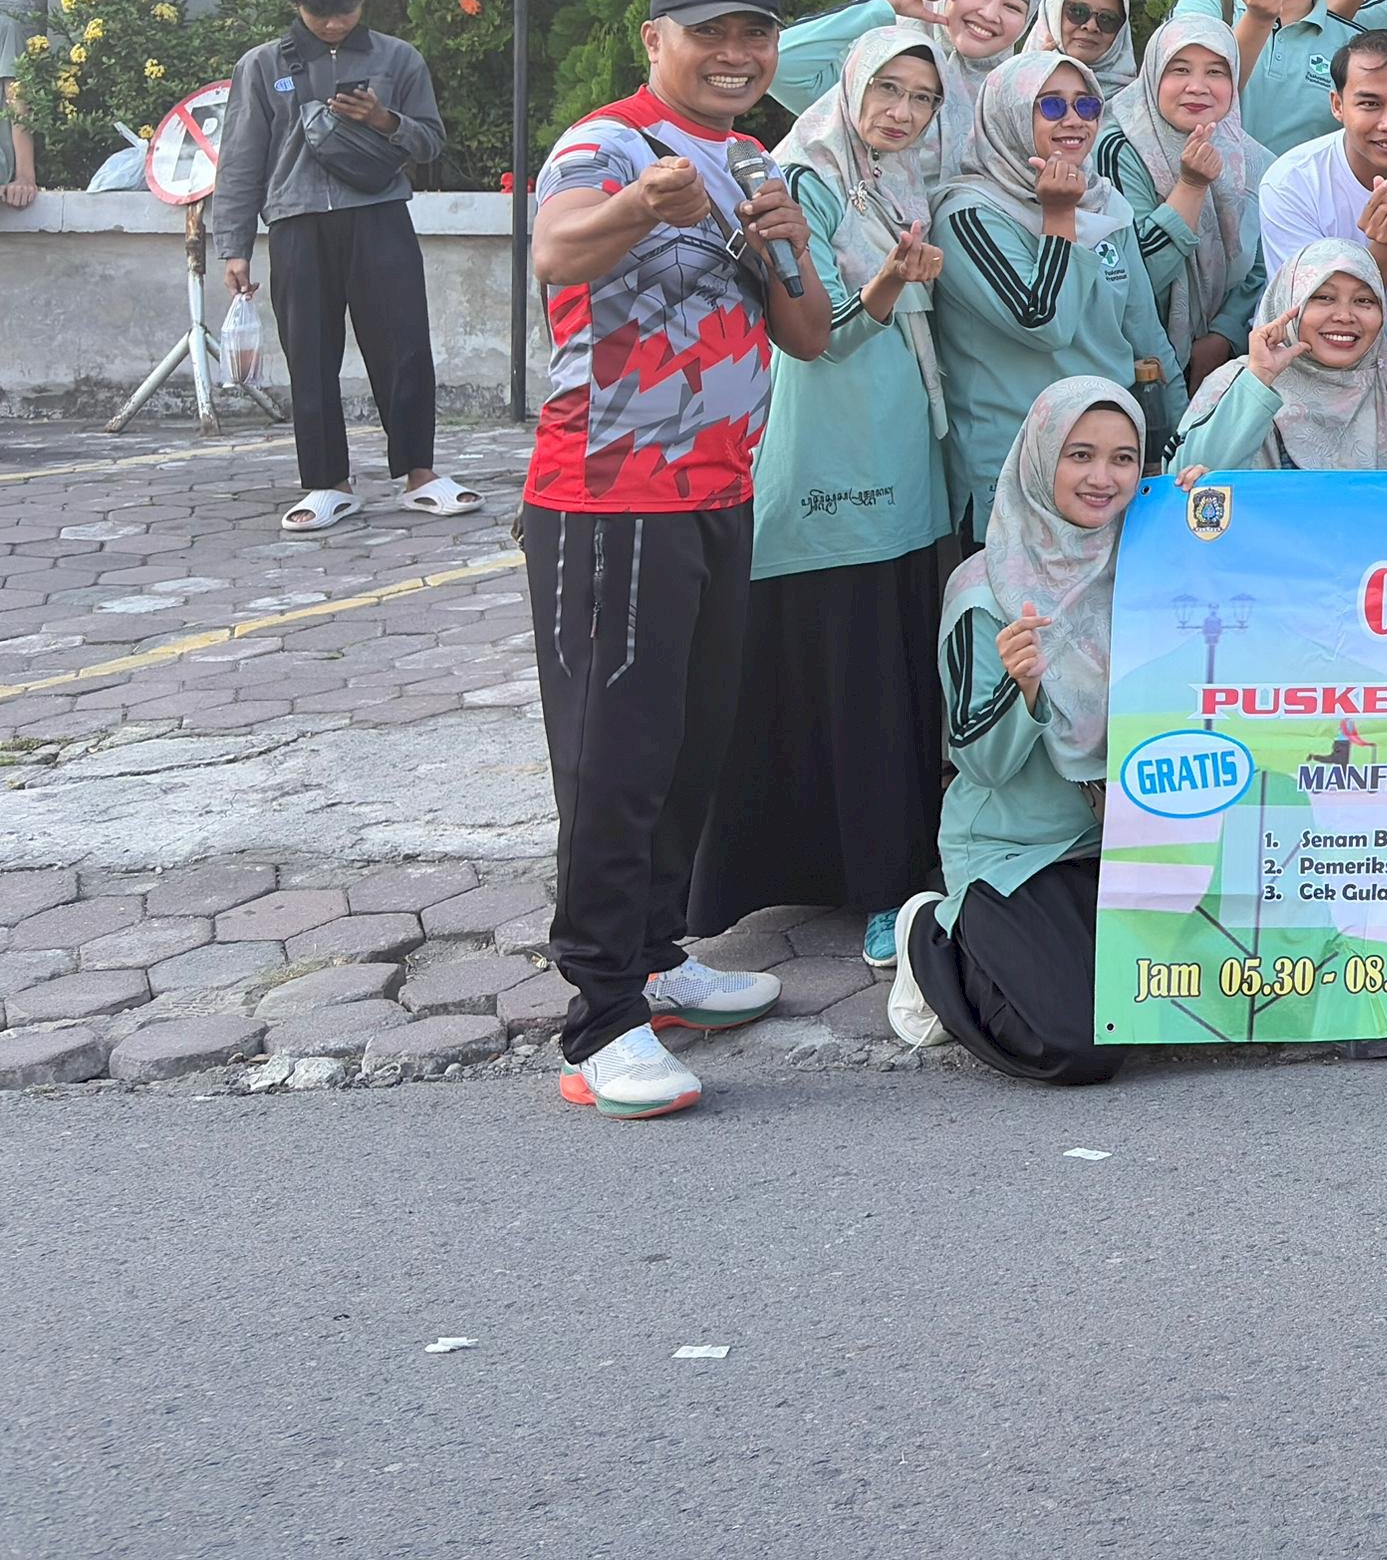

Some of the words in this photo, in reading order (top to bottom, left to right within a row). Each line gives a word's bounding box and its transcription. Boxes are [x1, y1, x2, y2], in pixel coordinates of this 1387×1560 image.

[1136, 750, 1239, 796] GRATIS
[1264, 831, 1280, 848] 1.
[1301, 830, 1368, 848] Senam
[1263, 858, 1283, 875] 2.
[1263, 885, 1283, 900] 3.
[1300, 883, 1337, 900] Cek
[1134, 958, 1201, 1003] Jam
[1219, 956, 1316, 997] 05.30
